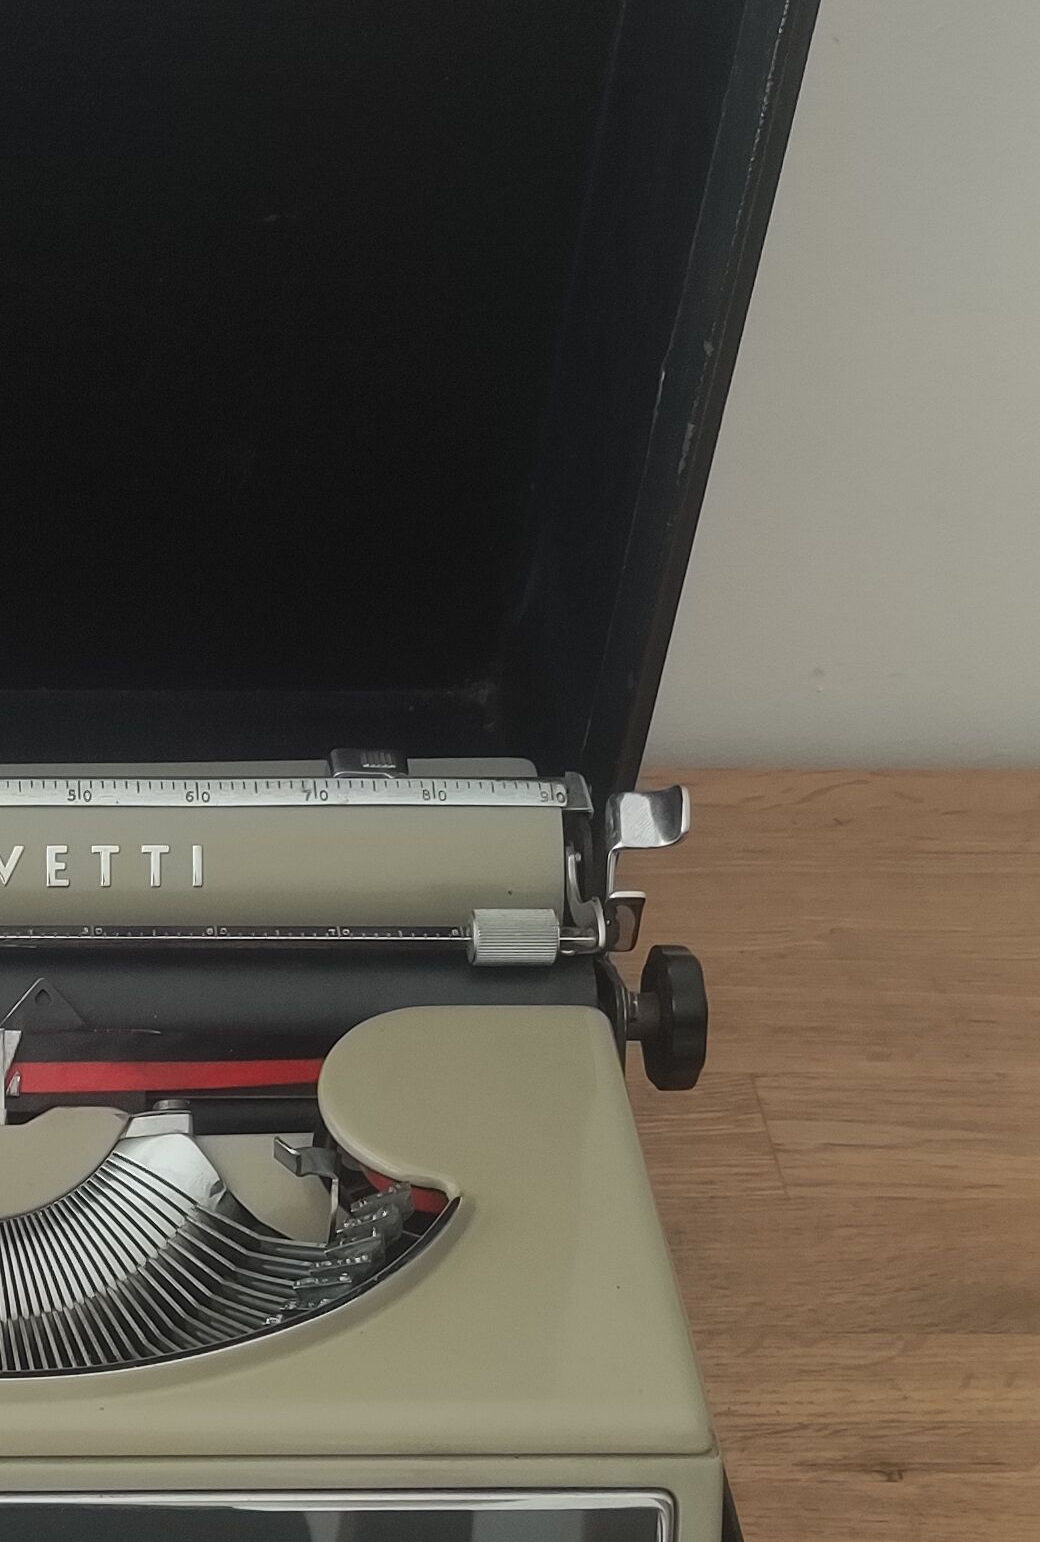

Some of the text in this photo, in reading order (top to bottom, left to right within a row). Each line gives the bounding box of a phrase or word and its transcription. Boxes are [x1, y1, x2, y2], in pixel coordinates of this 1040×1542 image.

[67, 788, 92, 802] 50
[185, 788, 210, 802] 60
[302, 788, 328, 801] 70
[423, 788, 446, 801] 80
[541, 788, 567, 803] 90
